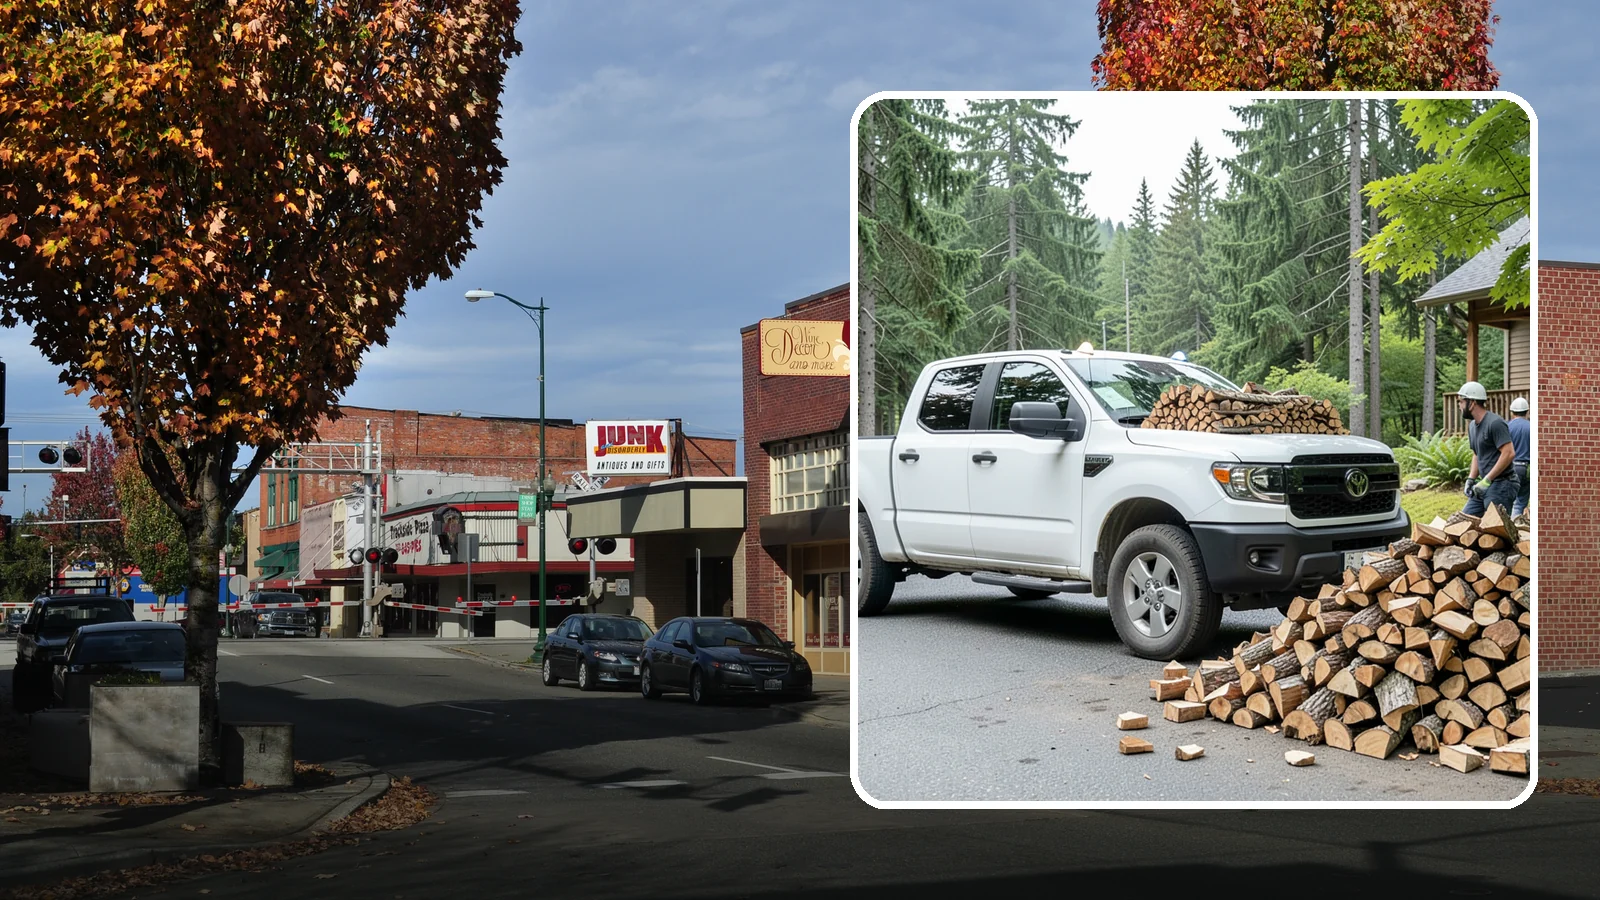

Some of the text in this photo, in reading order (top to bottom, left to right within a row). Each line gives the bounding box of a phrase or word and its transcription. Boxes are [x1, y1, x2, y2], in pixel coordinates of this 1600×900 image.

[595, 425, 665, 457] JUNK
[607, 446, 646, 454] DISORDERLY
[596, 460, 665, 470] ANTIQUES AND GIFTS
[414, 519, 429, 535] Pizza
